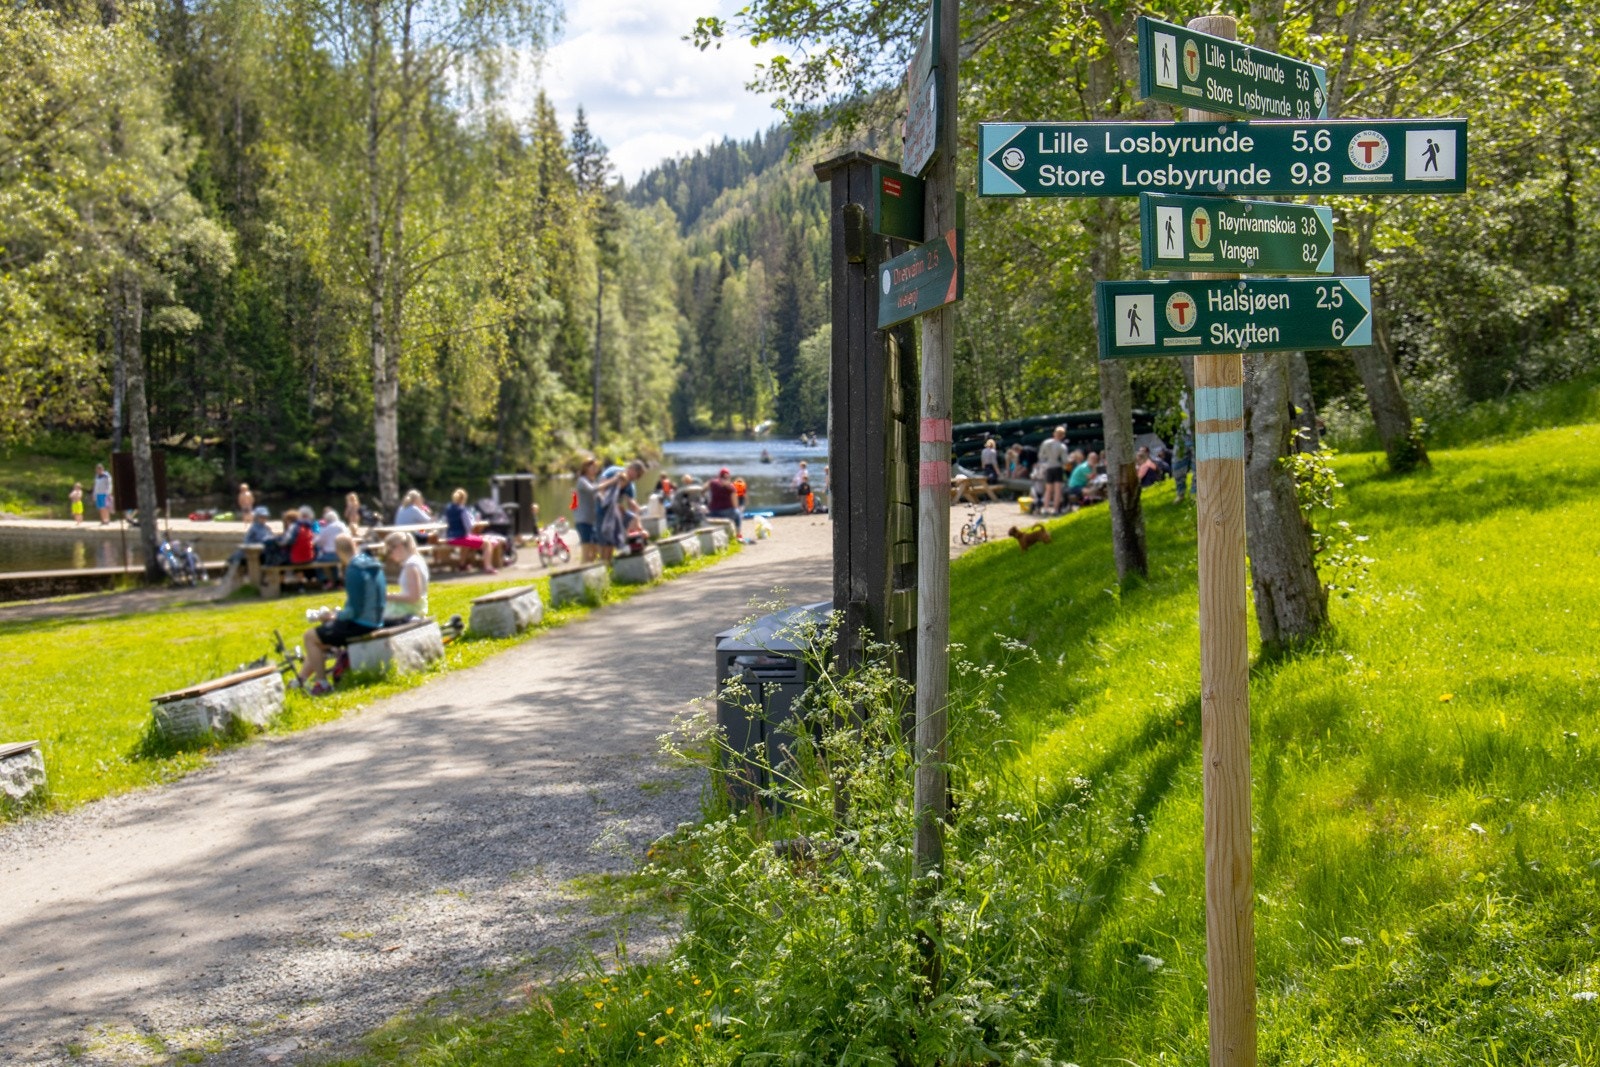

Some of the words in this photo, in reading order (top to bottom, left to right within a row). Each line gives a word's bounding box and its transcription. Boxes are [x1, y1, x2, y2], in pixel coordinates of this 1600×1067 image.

[1205, 43, 1226, 70] Lille
[1231, 50, 1285, 85] Losbyrunde
[1296, 69, 1309, 92] 5,6
[1206, 77, 1233, 104] Store
[1238, 85, 1291, 116] Losbyrunde
[1296, 99, 1311, 120] 9,8
[1038, 132, 1088, 154] Lille
[1105, 131, 1254, 157] Losbyrunde
[1291, 129, 1332, 154] 5,6
[1038, 164, 1106, 187] Store
[1122, 163, 1271, 190] Losbyrunde
[1290, 161, 1332, 187] 9,8
[1218, 211, 1297, 235] Røyrivannskoia
[1301, 216, 1317, 237] 3,8
[1219, 239, 1260, 264] Vangen
[1302, 243, 1318, 264] 8,2
[1208, 288, 1290, 315] Halsjøen
[1315, 286, 1343, 310] 2,5
[1210, 323, 1279, 348] Skytten
[1331, 318, 1344, 340] 6
